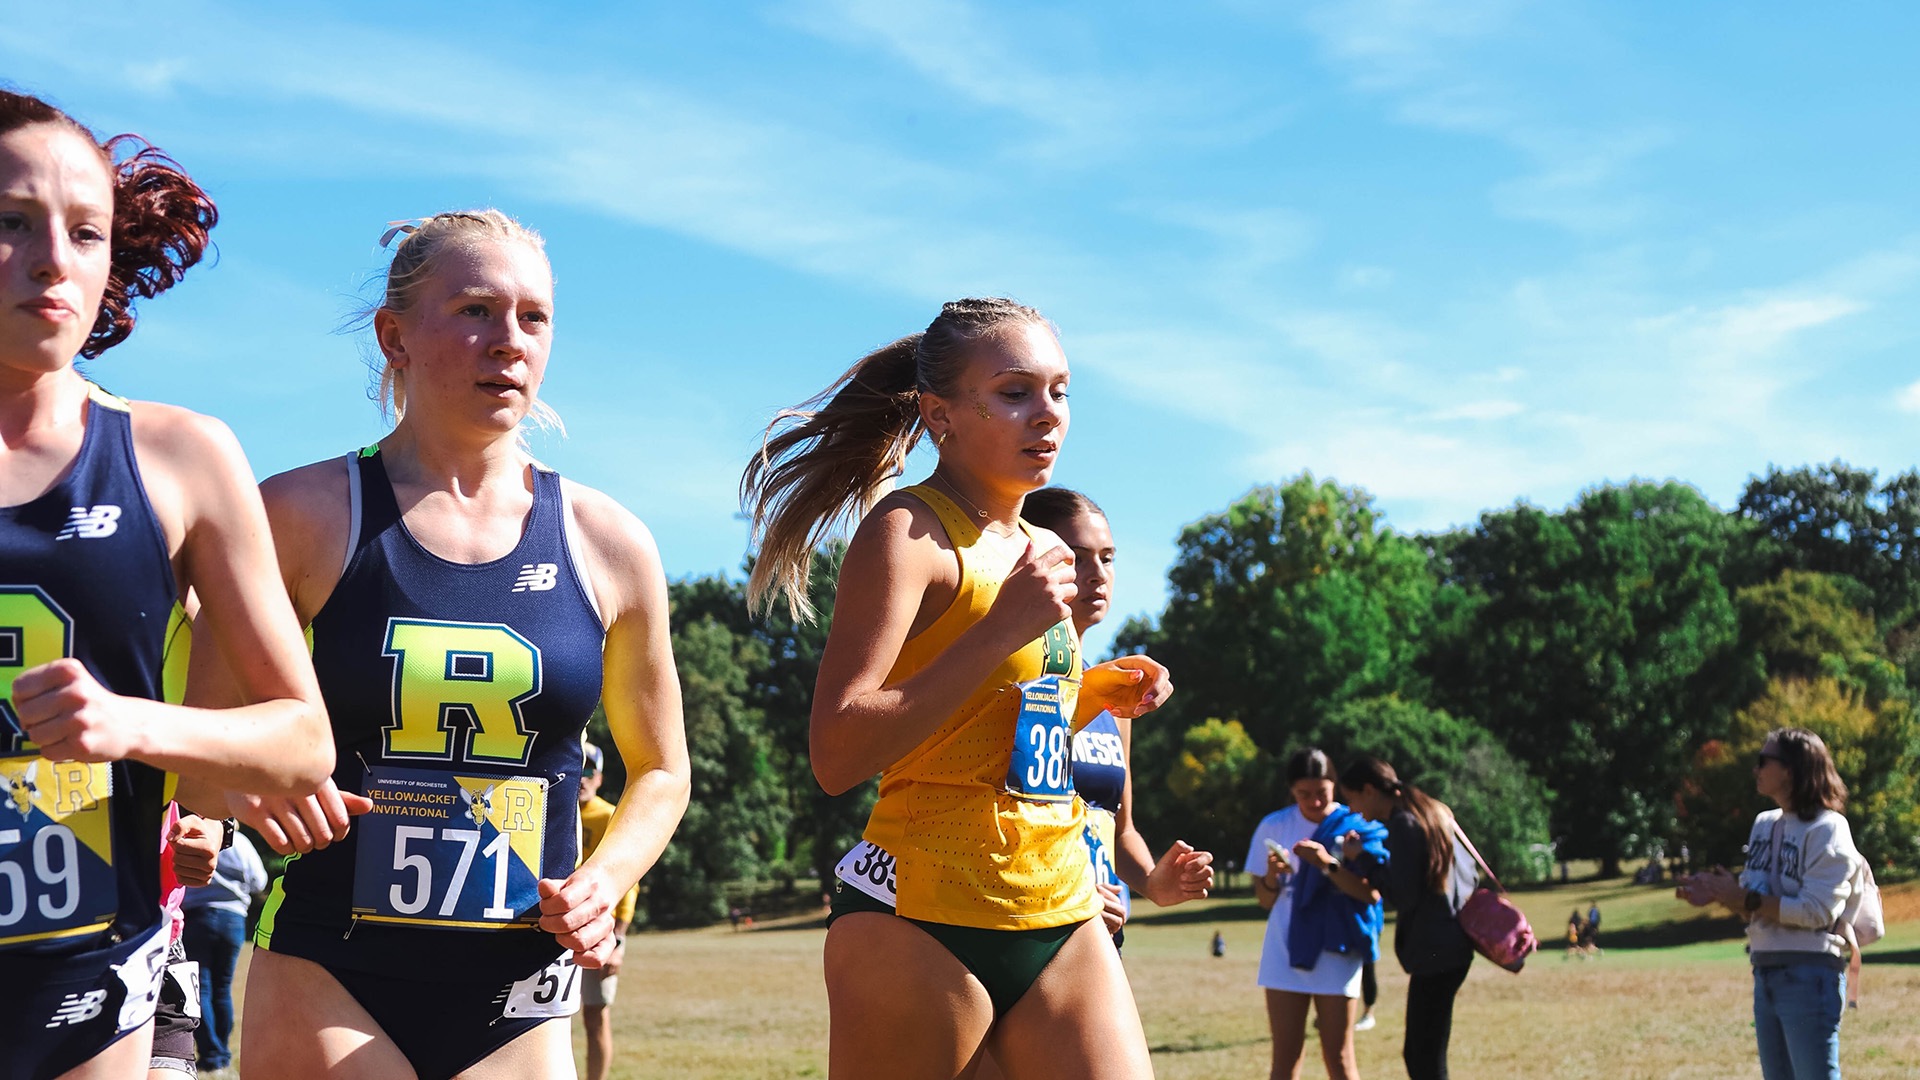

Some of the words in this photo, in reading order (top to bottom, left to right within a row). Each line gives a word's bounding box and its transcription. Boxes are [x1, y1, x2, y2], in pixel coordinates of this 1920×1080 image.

[381, 616, 543, 767] R
[1025, 691, 1059, 703] YELLOWJACKE
[1071, 730, 1127, 770] NESE
[52, 760, 98, 815] R
[367, 789, 458, 805] YELLOWJACKET
[416, 781, 448, 789] ROCHESTER
[372, 804, 450, 819] INVITATIONAL
[503, 787, 534, 832] R
[389, 825, 515, 920] 571
